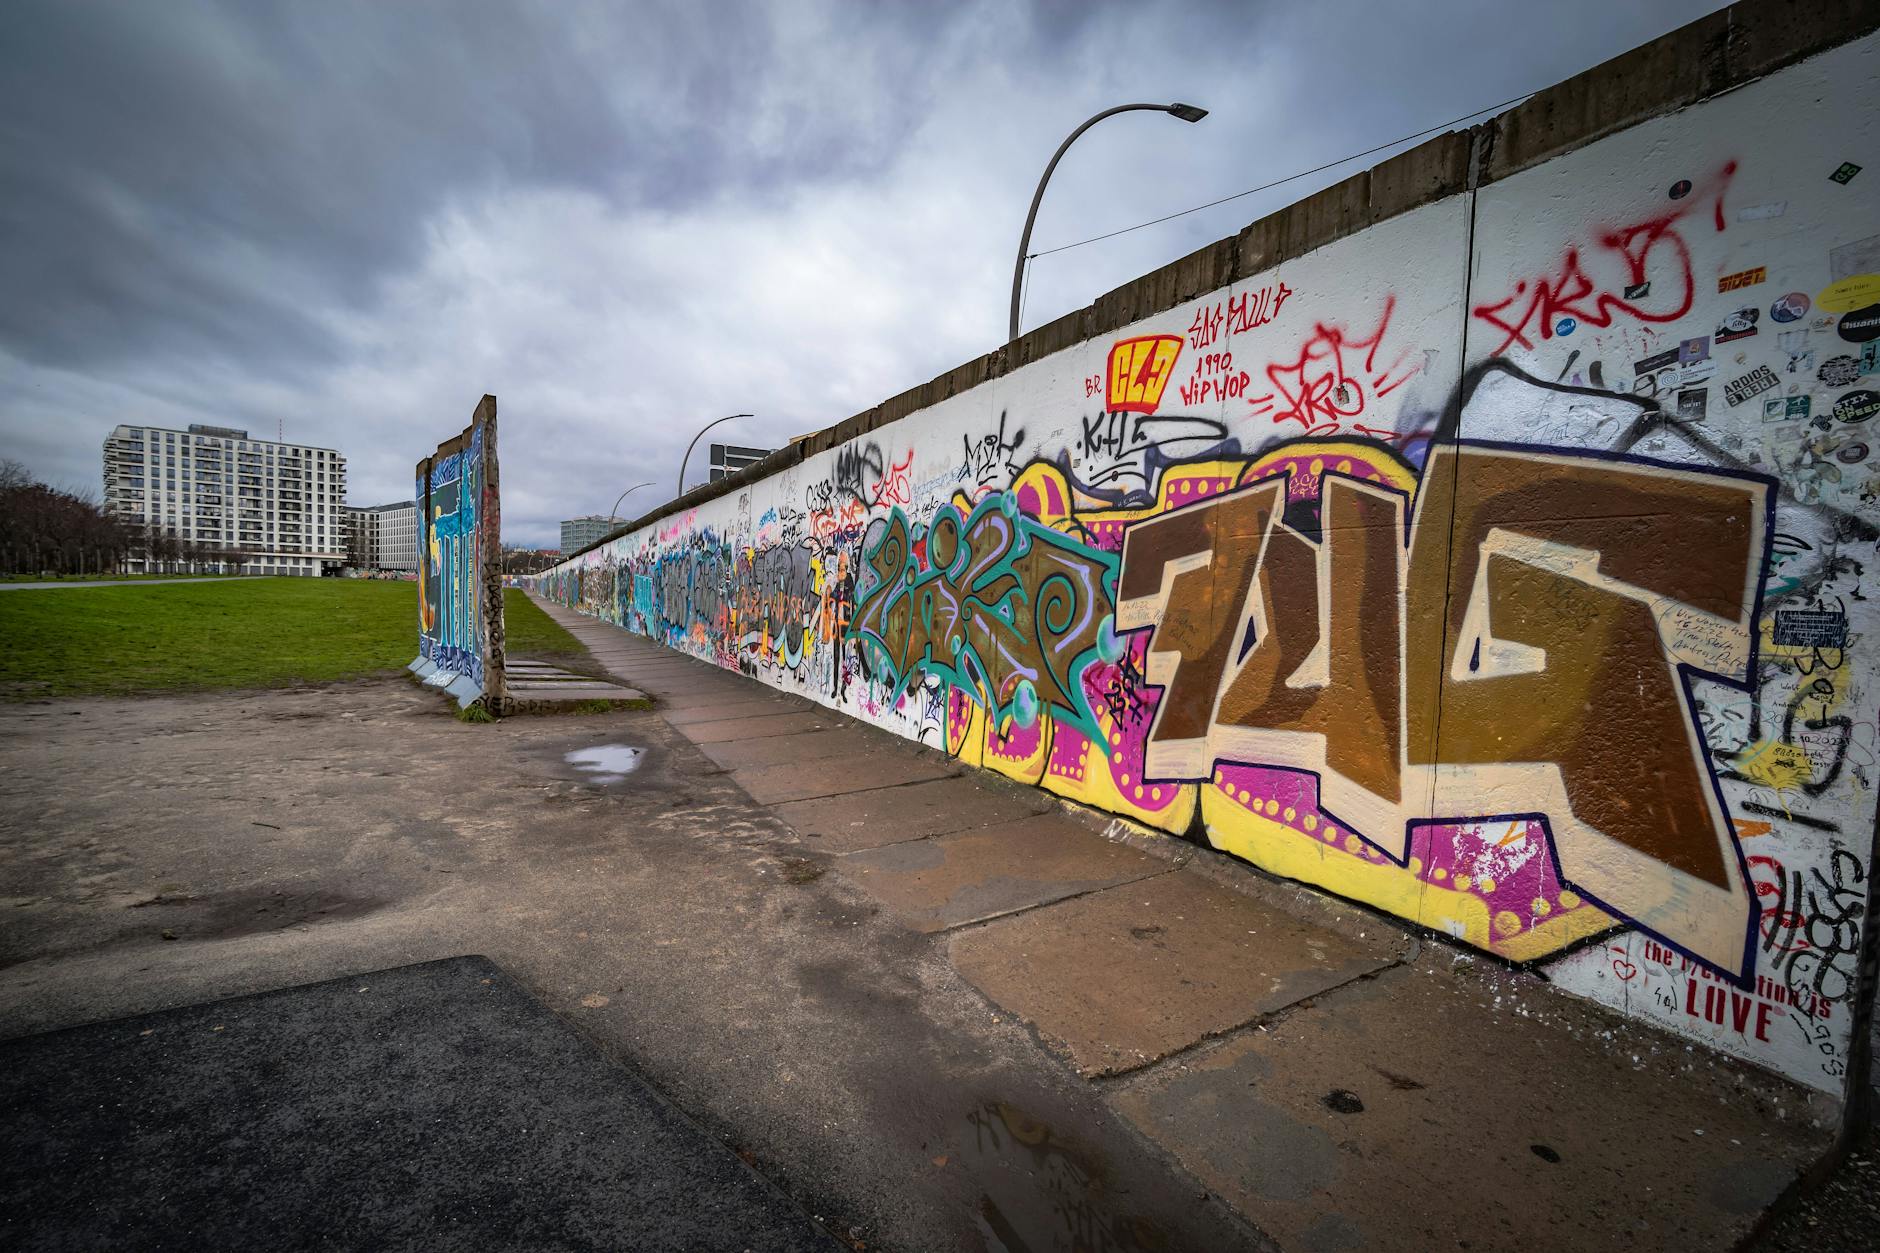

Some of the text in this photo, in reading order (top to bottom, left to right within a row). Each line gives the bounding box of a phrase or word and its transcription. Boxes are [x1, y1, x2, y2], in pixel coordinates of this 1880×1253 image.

[1723, 365, 1771, 396] ARDIOS
[1727, 375, 1779, 406] TREBLE
[1833, 393, 1869, 411] STIX
[1836, 404, 1855, 418] ON
[1644, 940, 1673, 966] the
[1685, 977, 1775, 1043] LOVE
